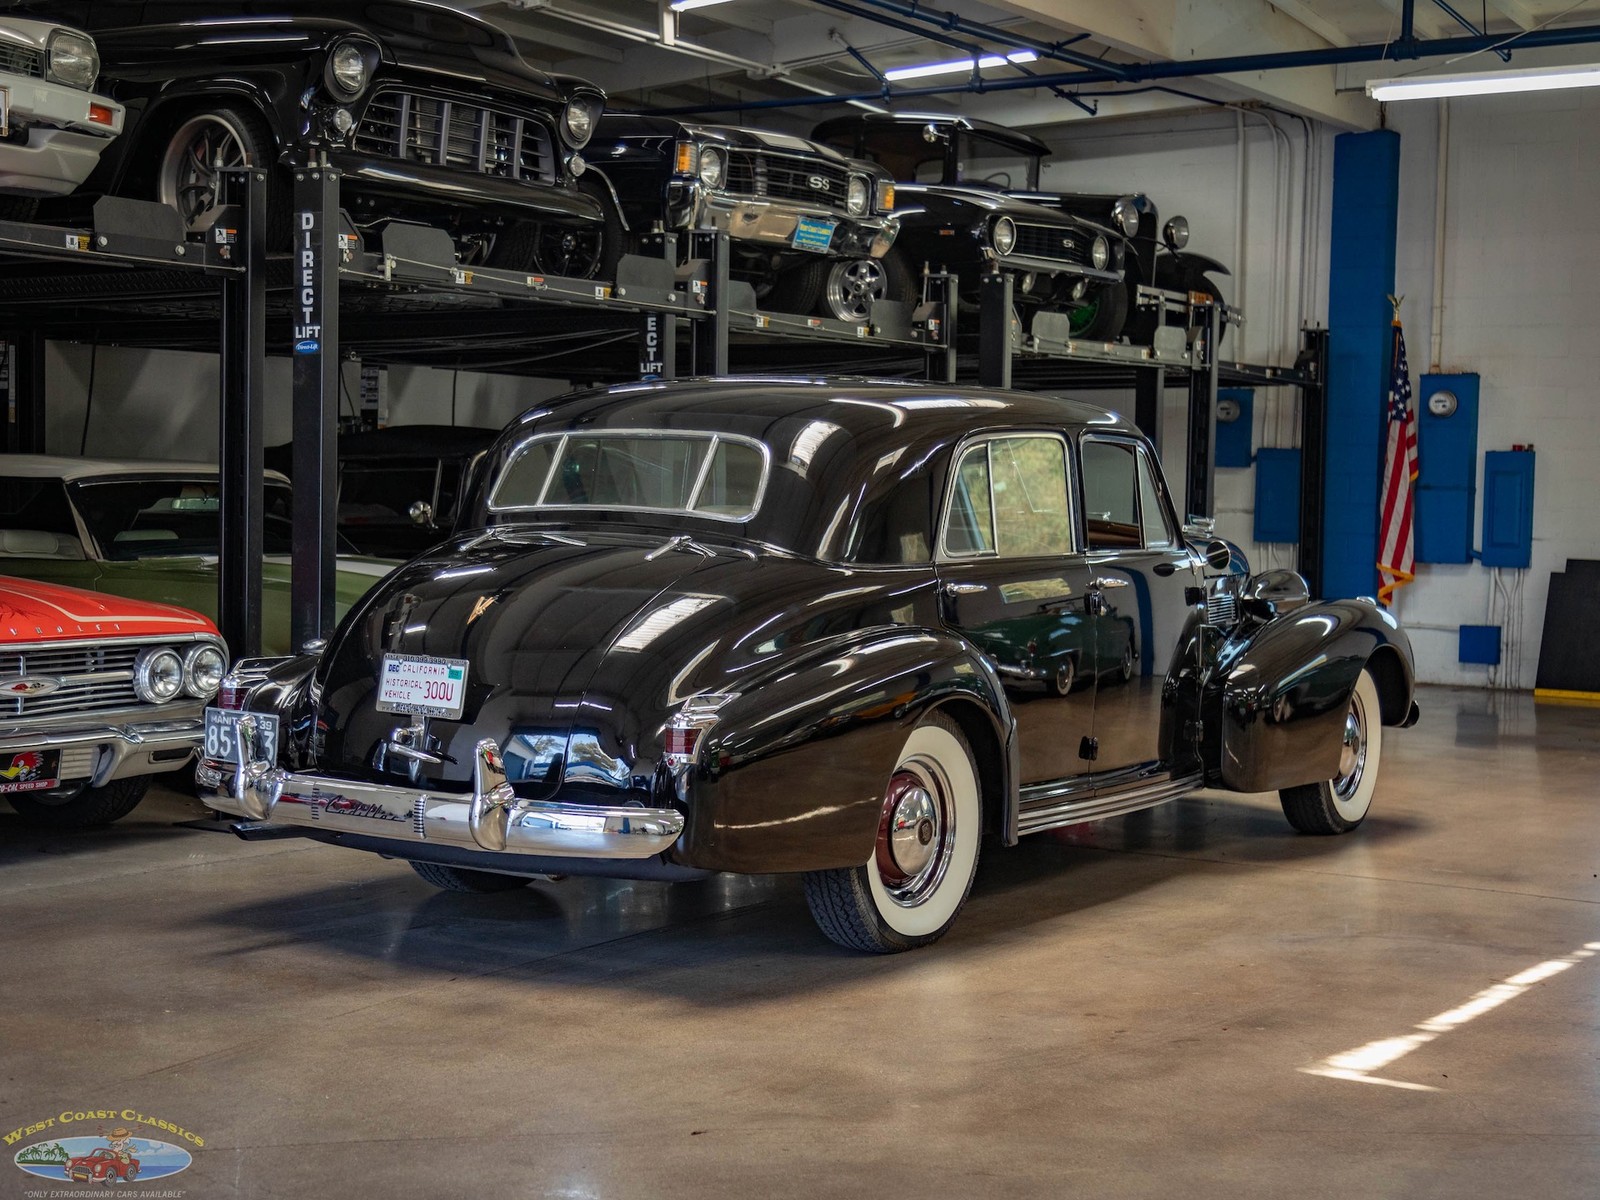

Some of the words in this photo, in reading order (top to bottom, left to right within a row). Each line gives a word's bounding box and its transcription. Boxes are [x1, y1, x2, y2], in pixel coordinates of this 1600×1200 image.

[809, 175, 830, 190] SS
[301, 213, 314, 324] DIRECT
[295, 325, 321, 339] LIFT
[646, 316, 658, 362] ECT
[640, 362, 663, 373] LIFT
[388, 664, 400, 673] DEC
[402, 664, 445, 675] CALIFORNIA
[384, 690, 411, 700] VEHICLE
[385, 678, 423, 689] HISTORICAL
[423, 680, 454, 702] 300U
[210, 714, 238, 726] MANIT
[260, 720, 272, 730] 39
[19, 782, 34, 790] SPEED
